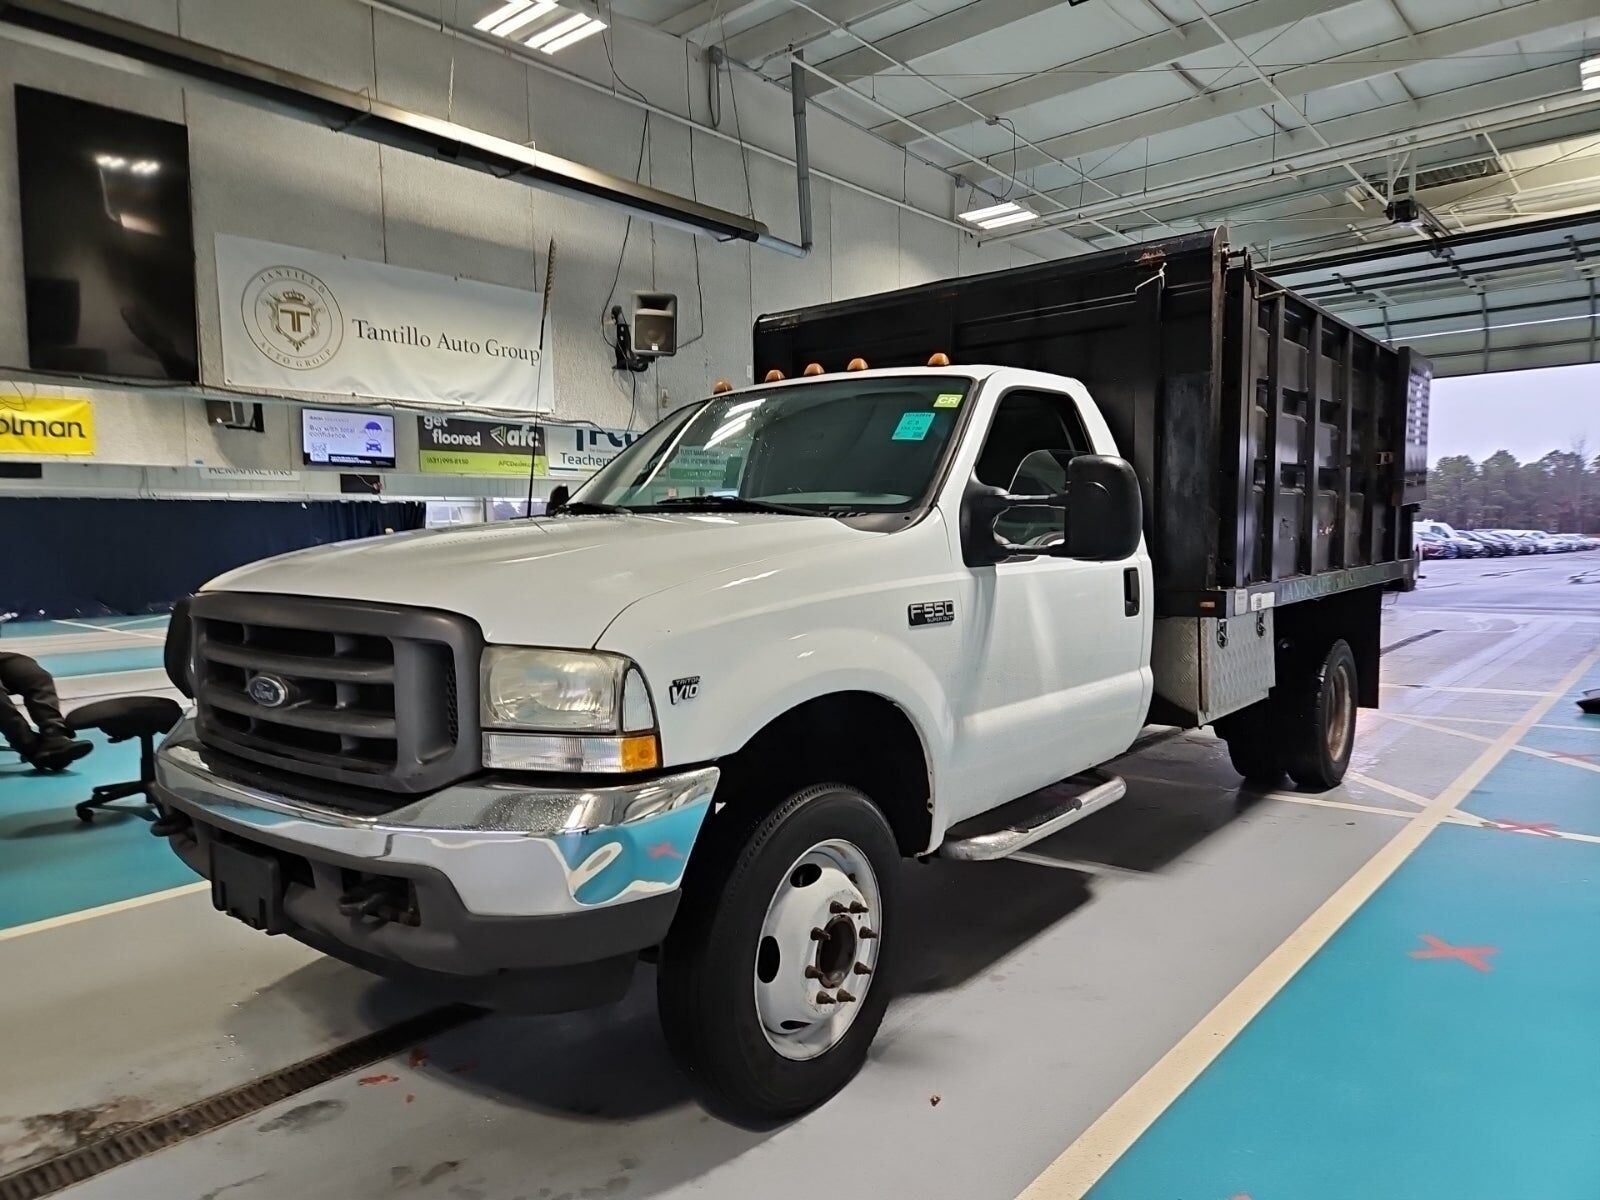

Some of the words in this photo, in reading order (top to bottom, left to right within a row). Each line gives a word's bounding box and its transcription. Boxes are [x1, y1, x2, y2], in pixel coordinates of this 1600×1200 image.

[259, 269, 325, 294] TANTILLO
[352, 319, 431, 348] Tantillo
[437, 332, 480, 354] Auto
[485, 338, 540, 366] Group
[260, 342, 291, 365] AUTO
[296, 348, 331, 367] GROUP
[938, 396, 958, 405] CR
[424, 415, 448, 429] get
[432, 428, 481, 446] floored
[676, 676, 700, 686] TRITON
[671, 684, 699, 704] V10
